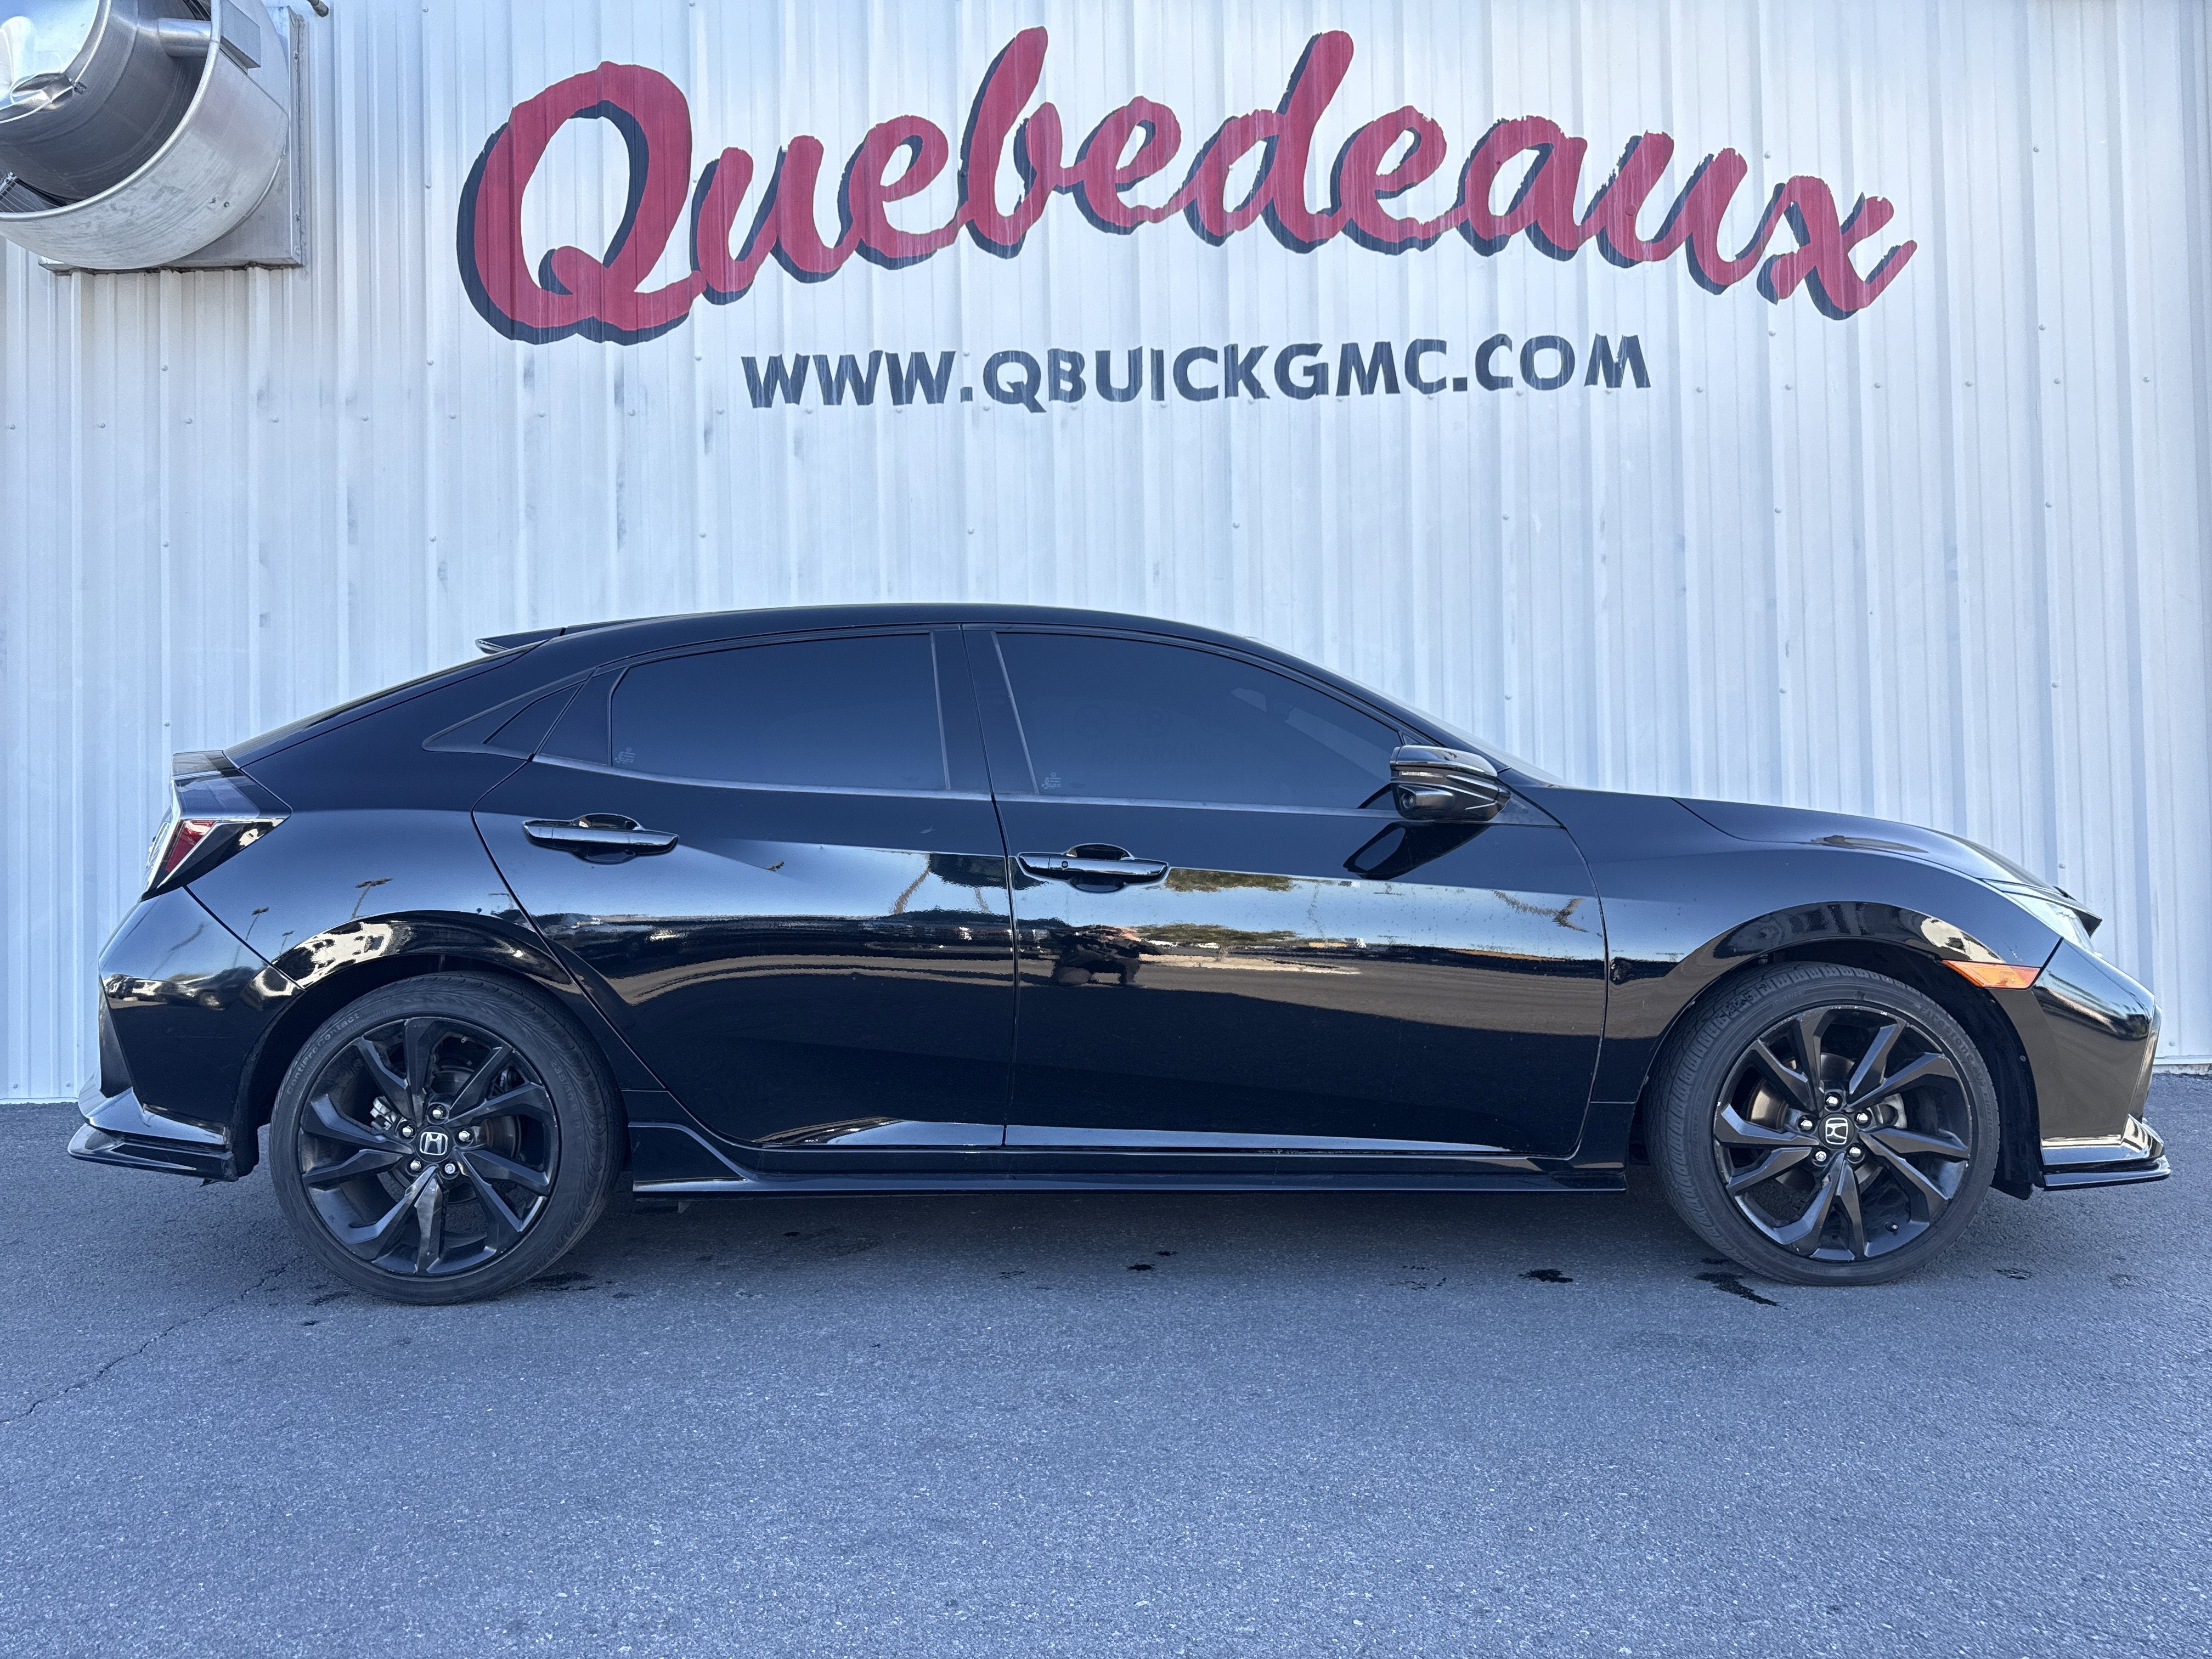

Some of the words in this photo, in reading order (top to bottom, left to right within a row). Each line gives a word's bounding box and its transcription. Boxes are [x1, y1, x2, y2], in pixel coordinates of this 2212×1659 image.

[458, 26, 1917, 345] Quebedeaux
[741, 334, 1651, 414] WWW.QBUICKGMC.COM
[1919, 1005, 1974, 1063] Firestone
